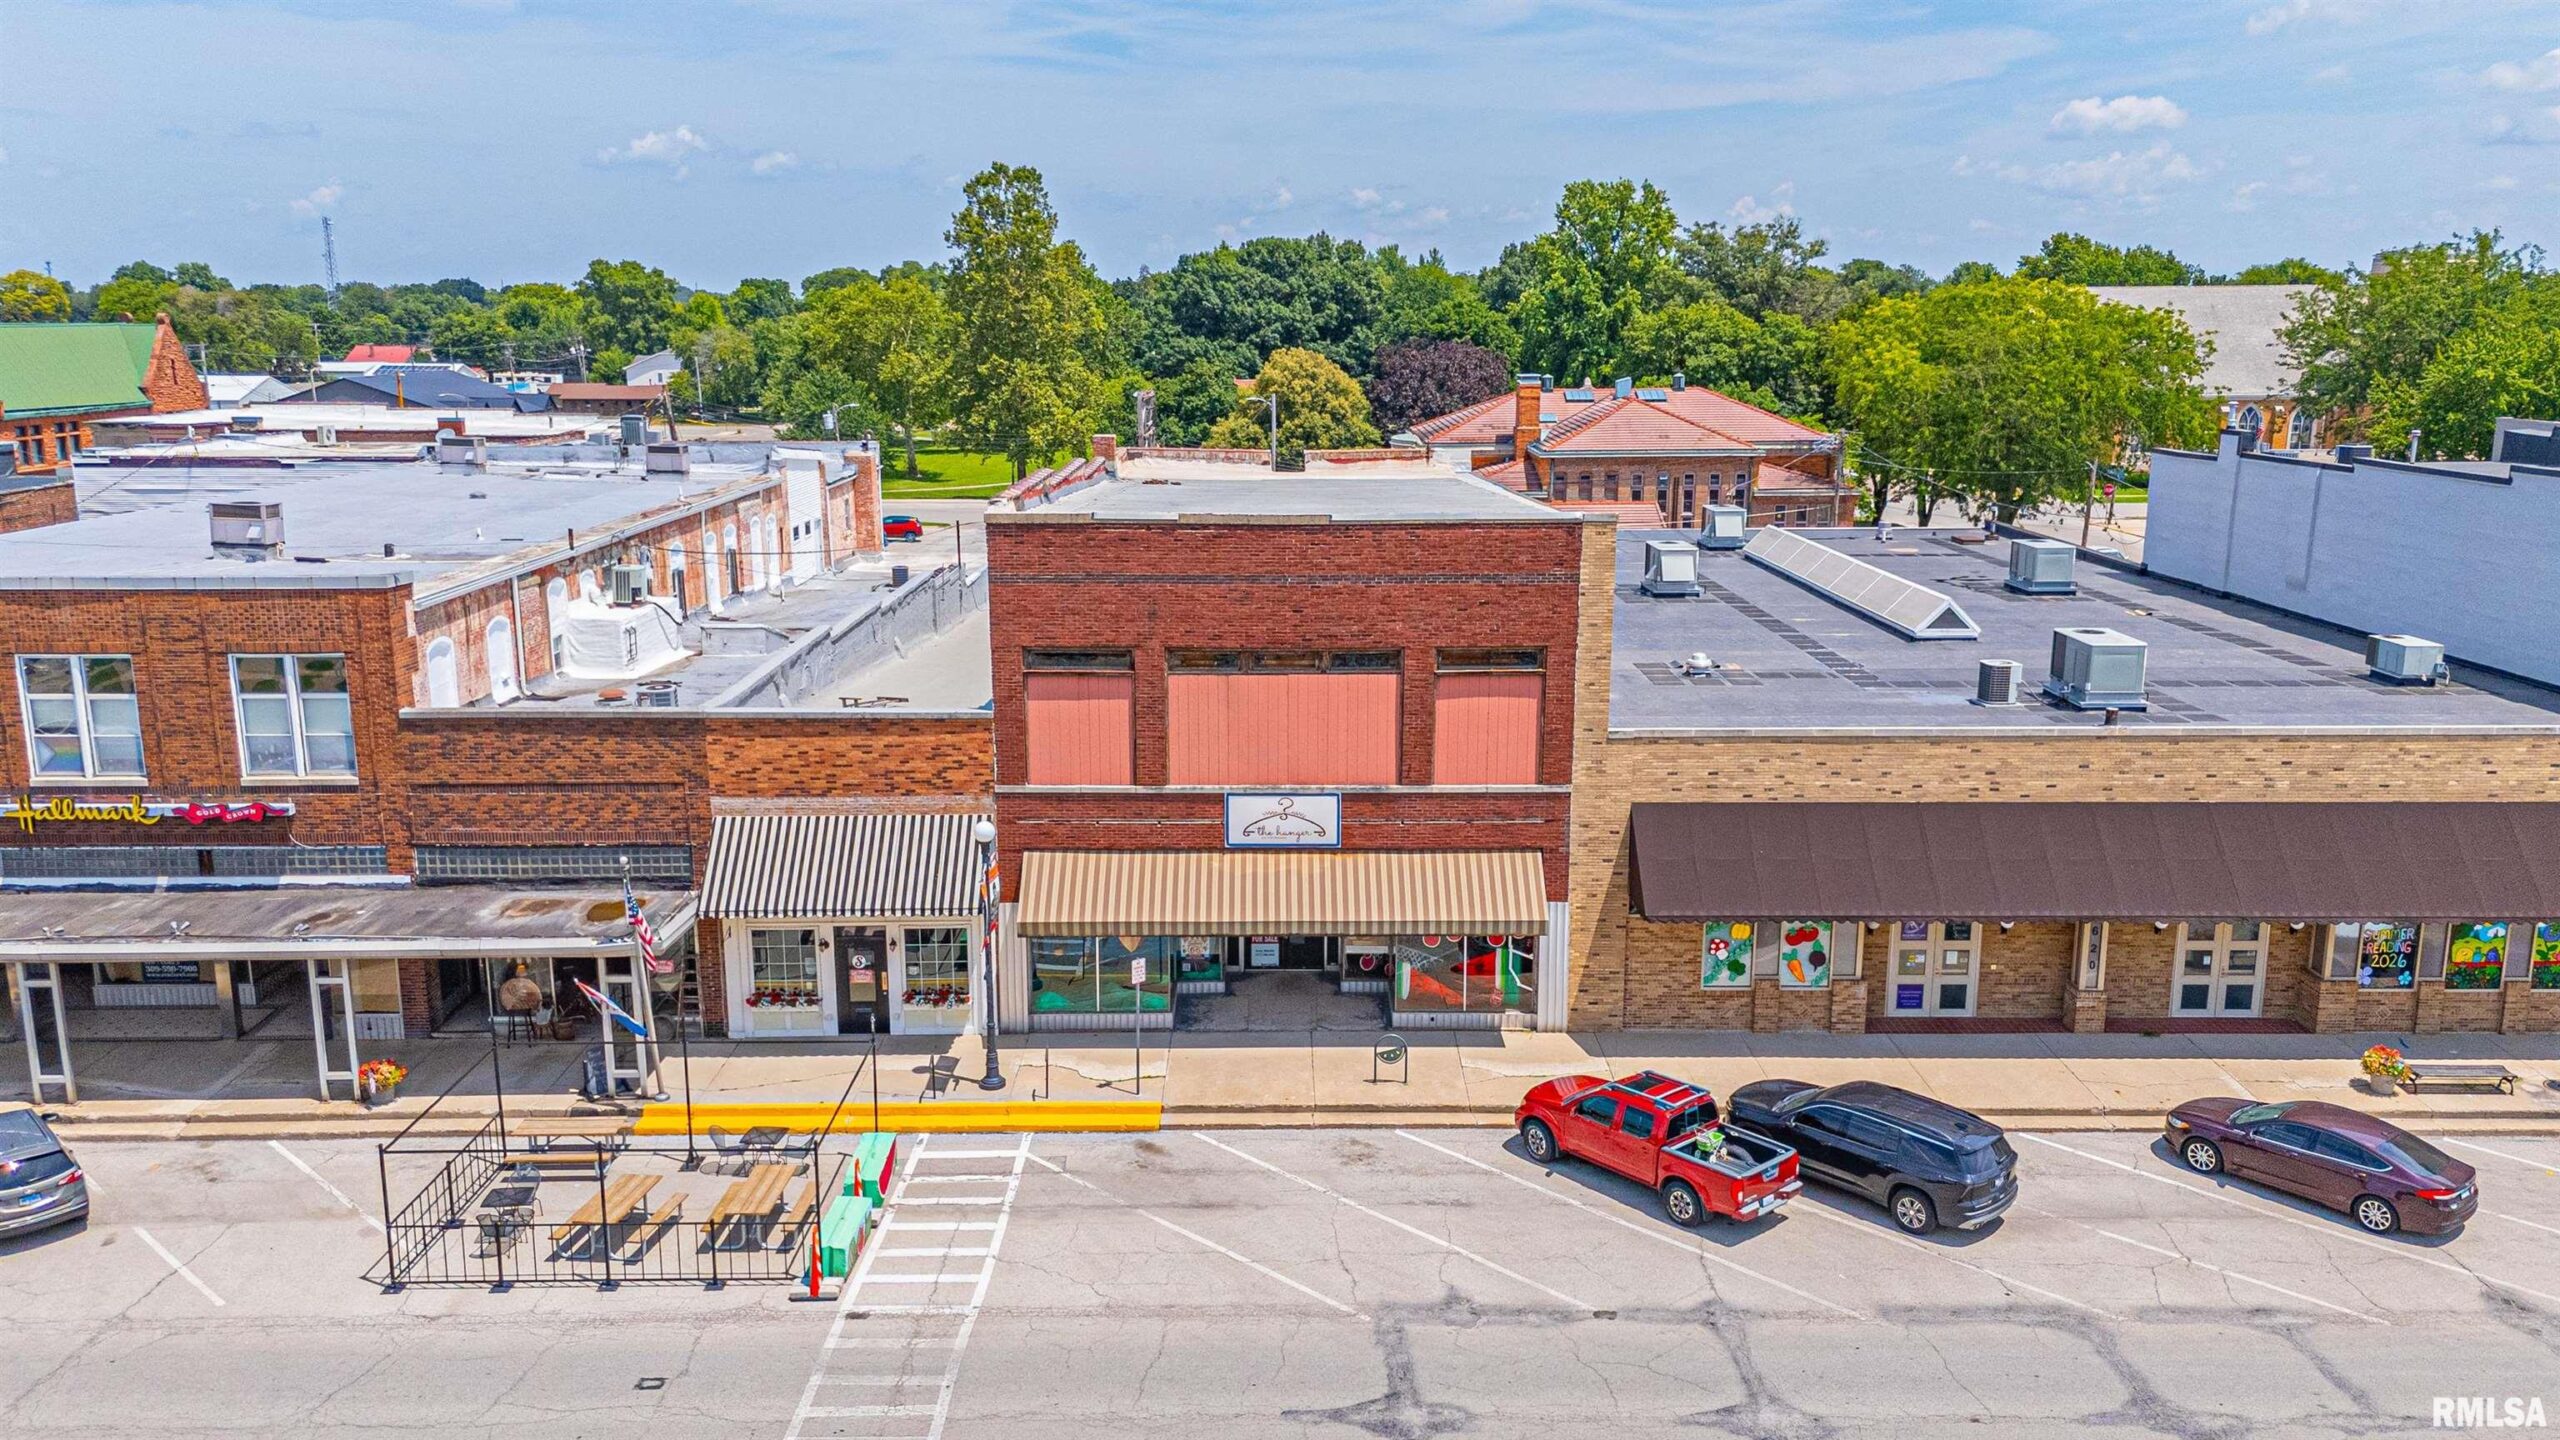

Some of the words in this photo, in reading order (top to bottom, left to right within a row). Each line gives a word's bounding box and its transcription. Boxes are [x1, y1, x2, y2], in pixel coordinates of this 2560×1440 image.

[4, 795, 161, 834] Hallmark
[196, 808, 221, 816] GOLD
[226, 809, 256, 819] CROWN
[1256, 825, 1274, 836] the
[1276, 825, 1312, 842] hanger
[2364, 928, 2415, 941] SUMMER
[2365, 941, 2413, 954] READING
[2370, 953, 2407, 968] 2026
